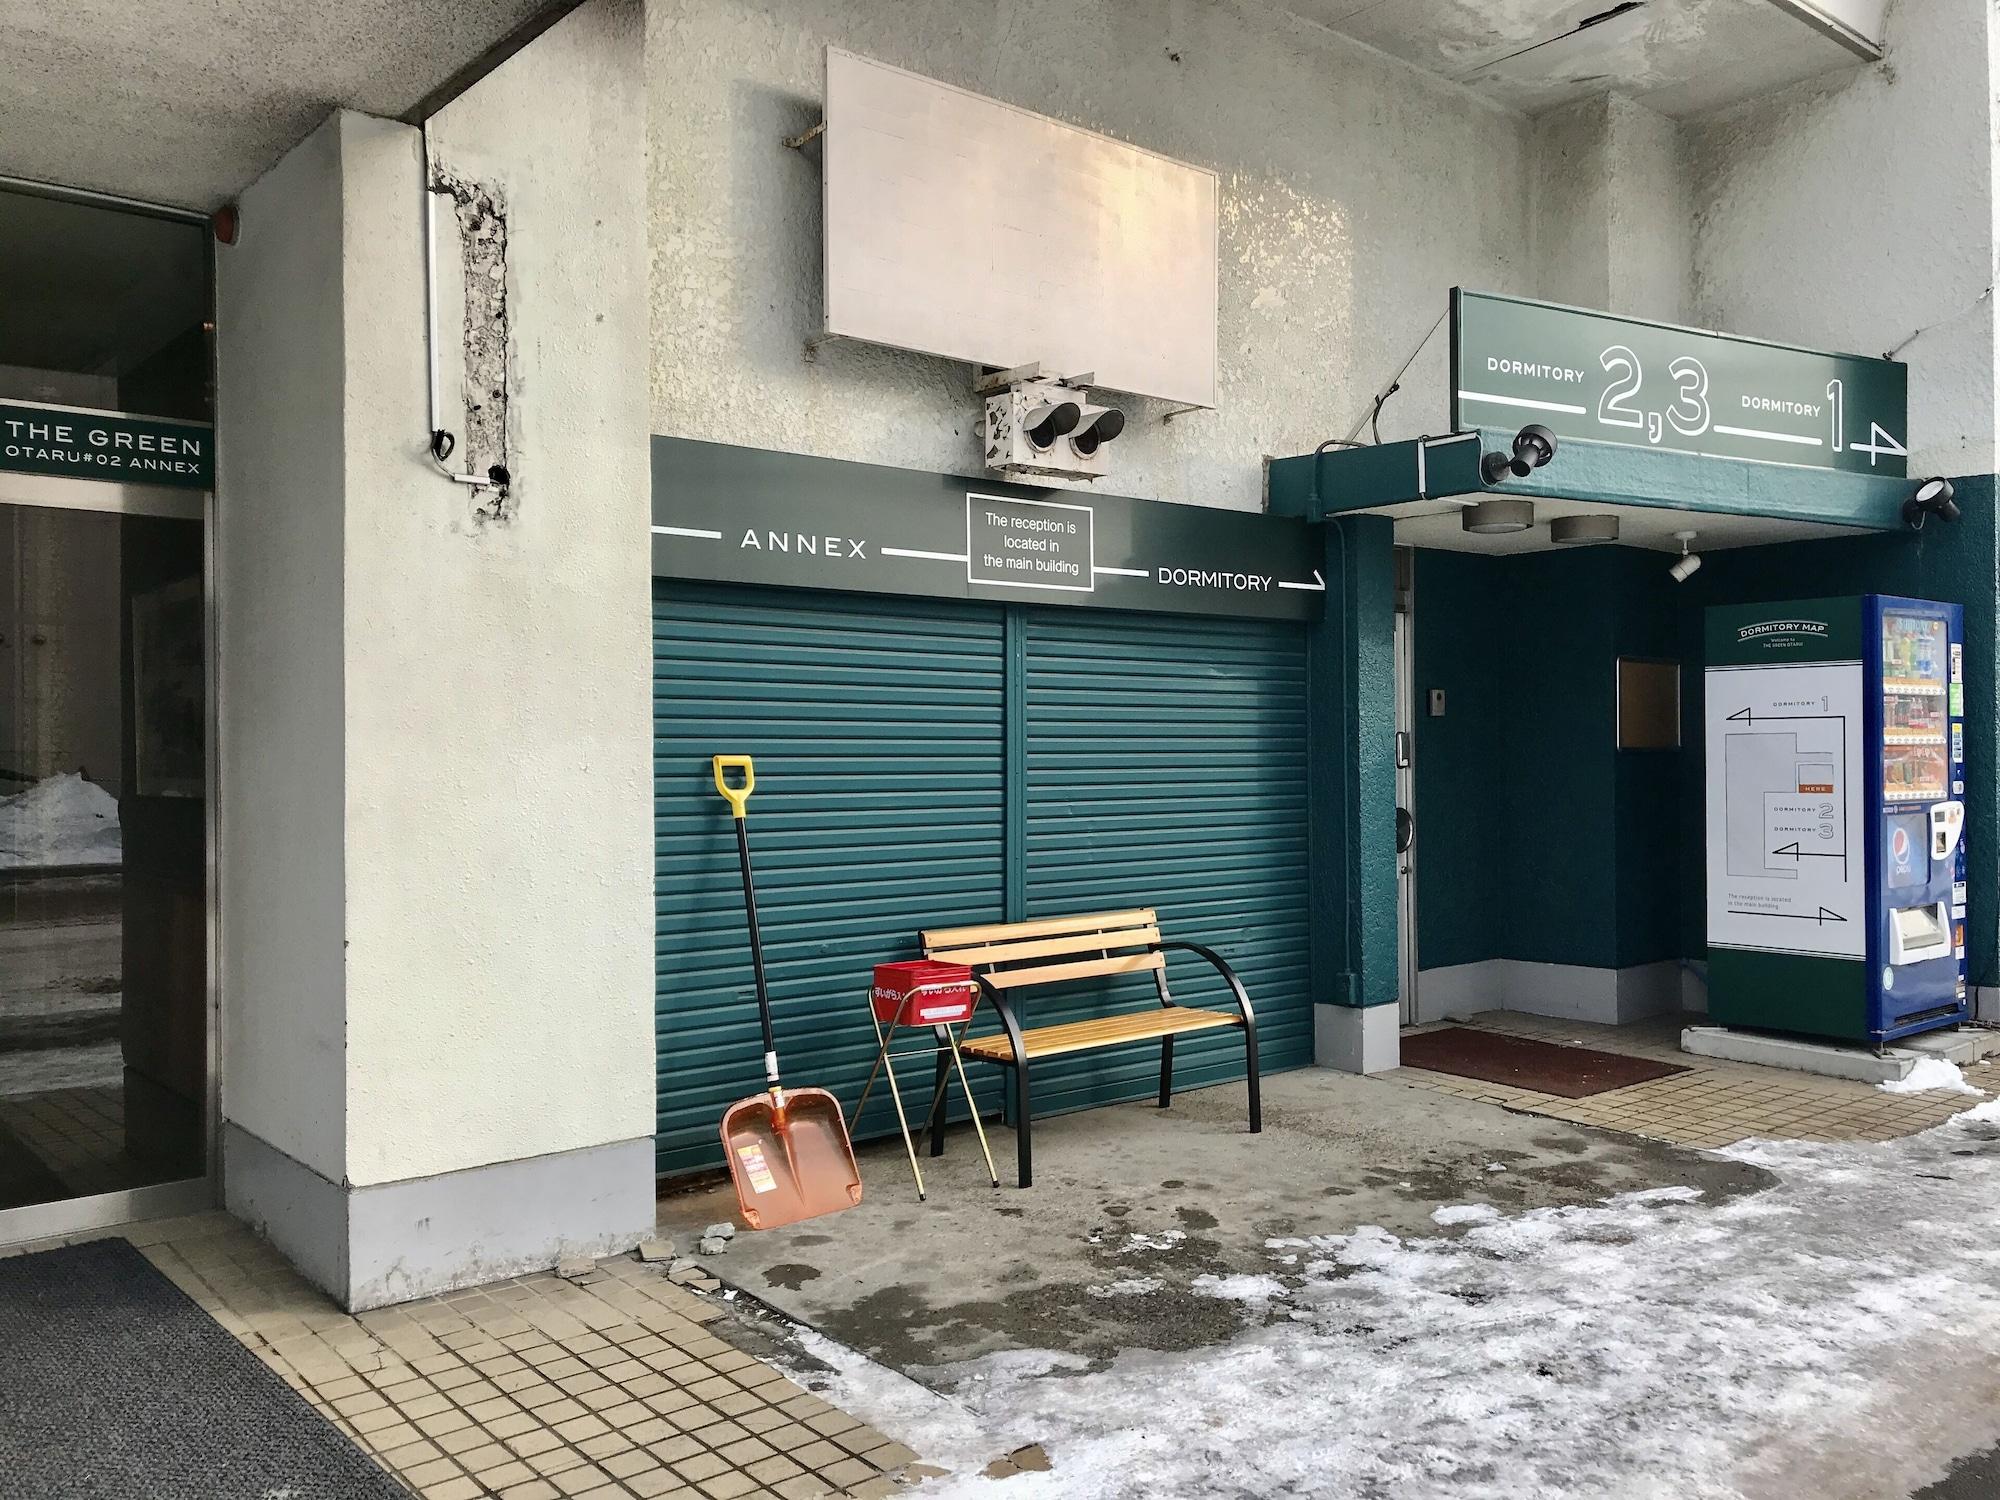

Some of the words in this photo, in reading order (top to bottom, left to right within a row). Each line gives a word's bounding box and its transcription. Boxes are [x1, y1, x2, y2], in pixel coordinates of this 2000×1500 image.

[1487, 357, 1584, 383] DORMITORY
[1598, 345, 1710, 443] 2,3
[1741, 395, 1821, 417] DORMITORY
[1827, 379, 1842, 452] 1
[5, 420, 73, 443] THE
[88, 429, 200, 456] GREEN
[5, 445, 121, 467] OTARU#02
[129, 457, 199, 474] ANNEX
[985, 512, 1008, 526] The
[1011, 517, 1064, 533] reception
[1067, 521, 1076, 534] is
[740, 528, 866, 559] ANNEX
[1004, 535, 1046, 552] located
[1050, 540, 1059, 552] in
[984, 554, 1003, 568] the
[1006, 557, 1033, 570] main
[1036, 559, 1079, 576] building
[1158, 567, 1272, 592] DORMITORY
[1740, 623, 1800, 637] DORMITORY
[1802, 624, 1825, 632] MAP
[1821, 695, 1829, 711] 1
[1819, 802, 1834, 819] 2
[1818, 822, 1834, 839] 3
